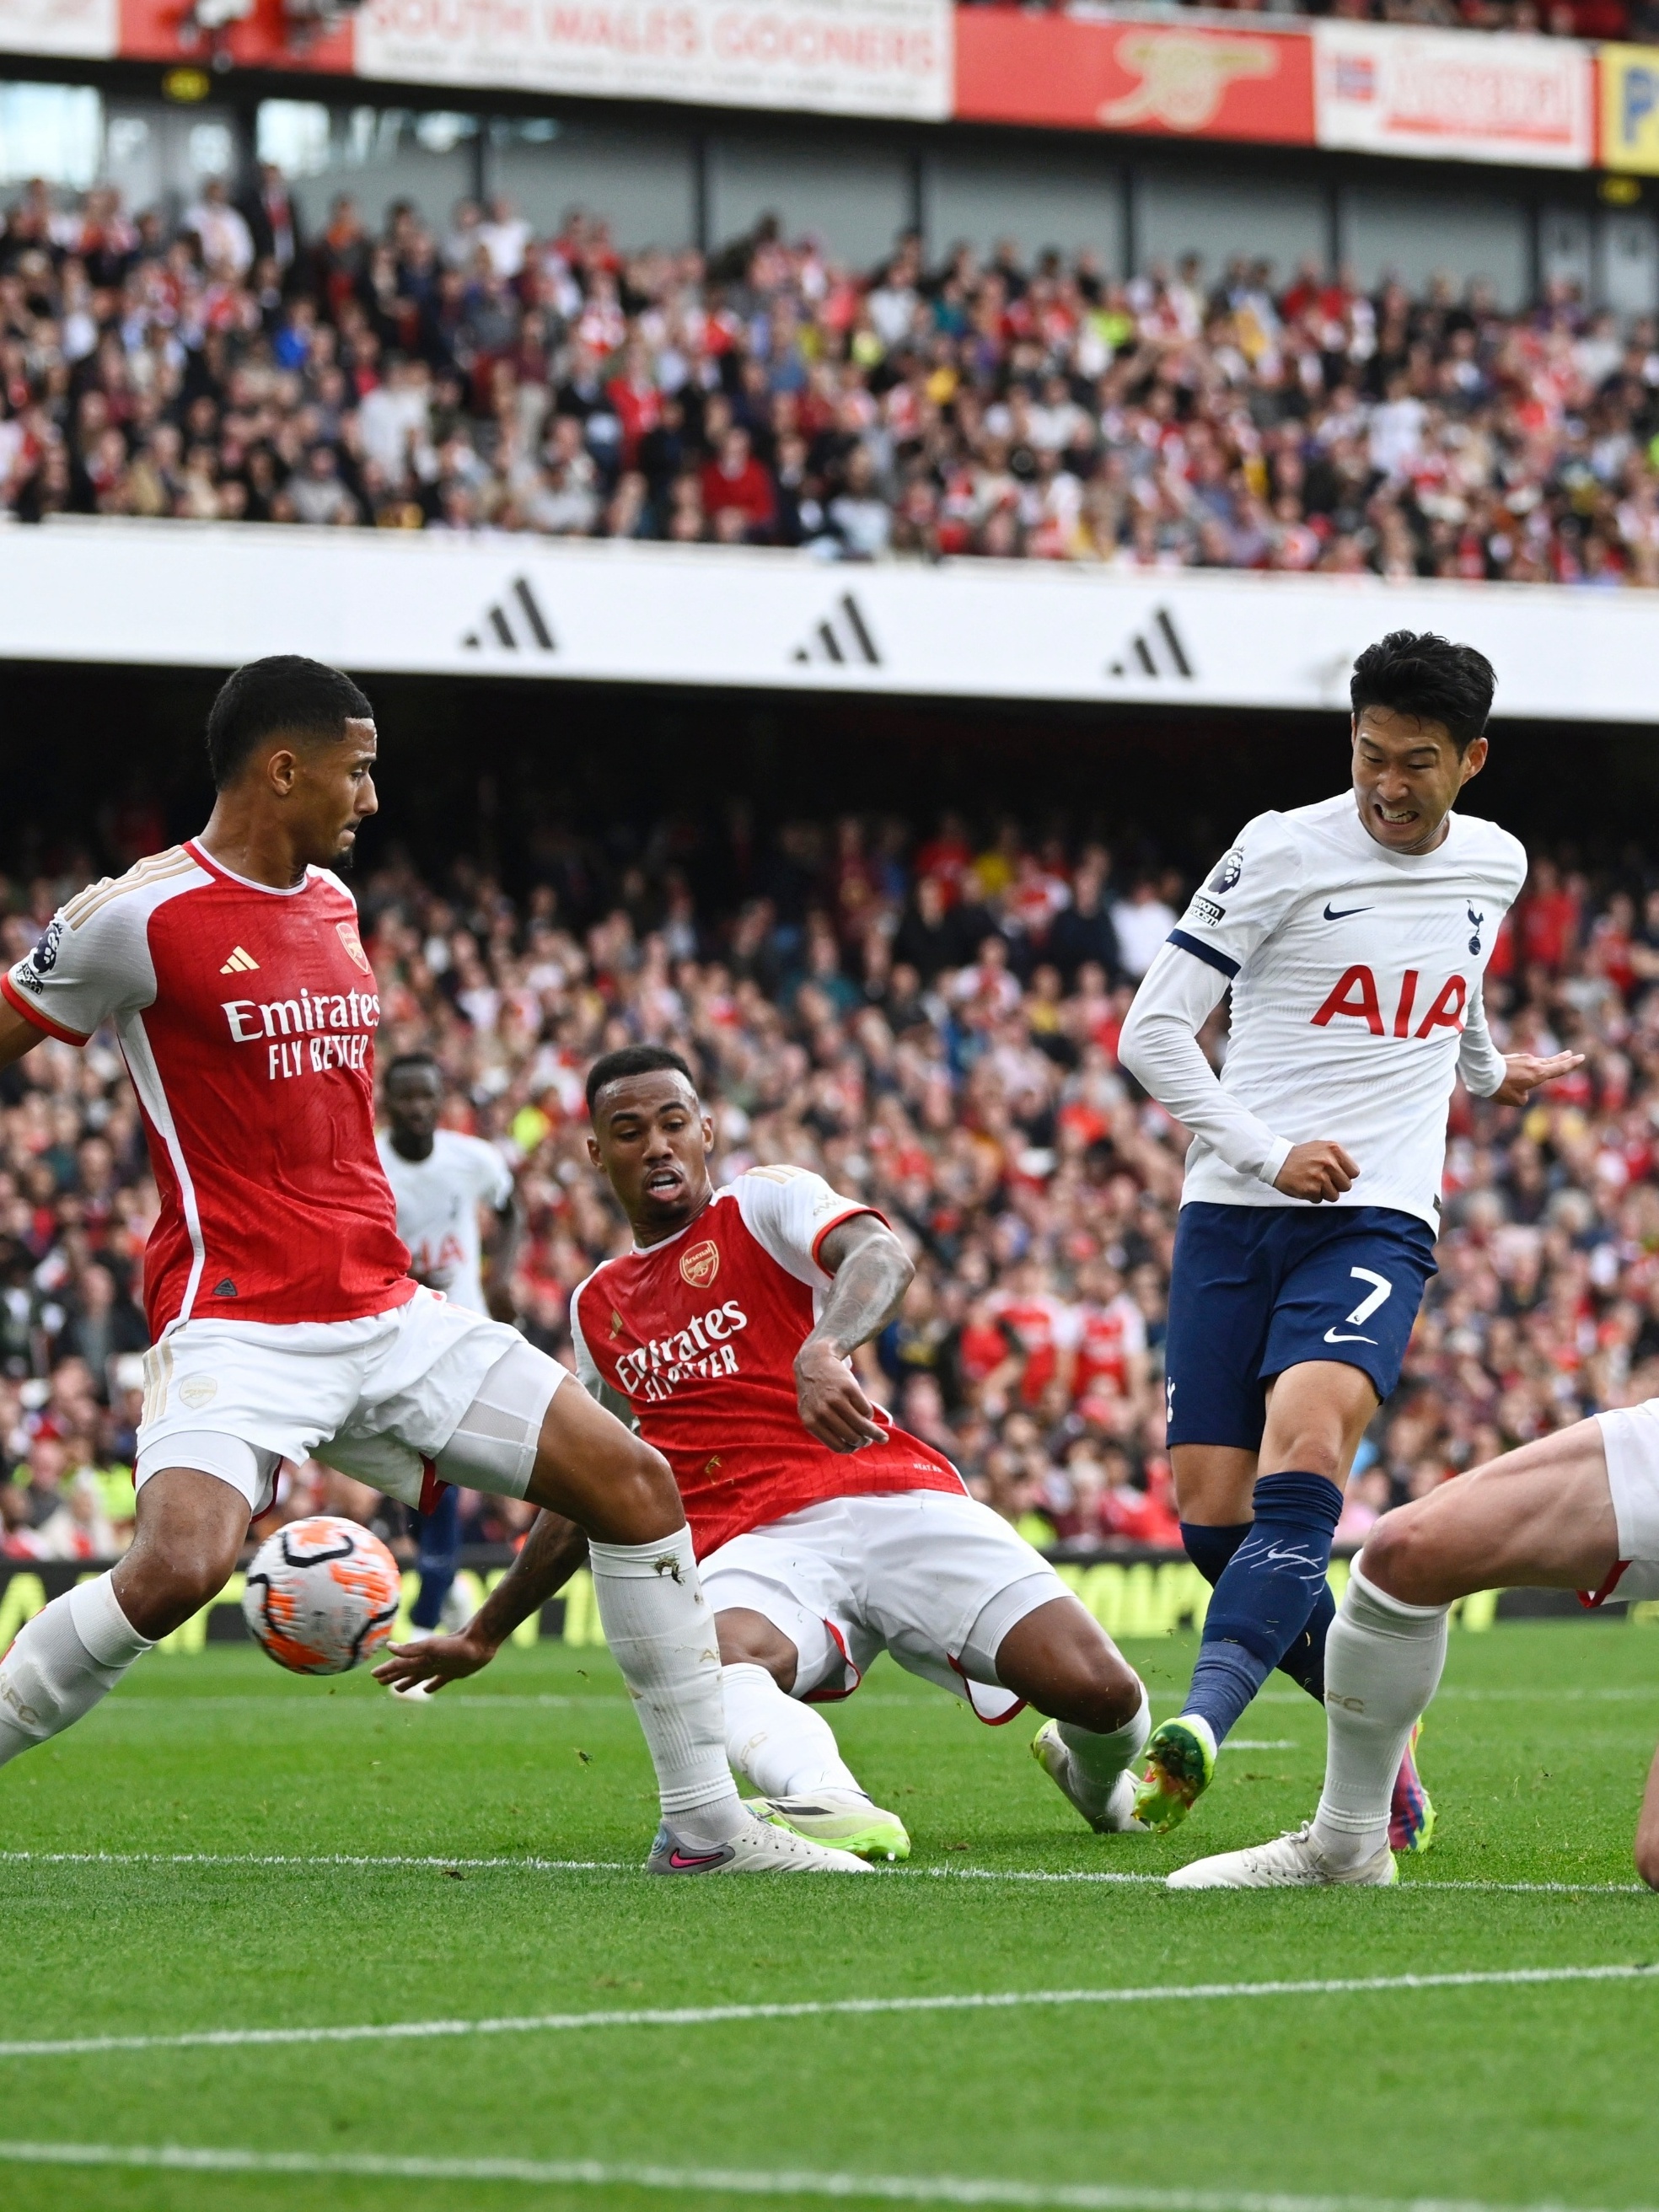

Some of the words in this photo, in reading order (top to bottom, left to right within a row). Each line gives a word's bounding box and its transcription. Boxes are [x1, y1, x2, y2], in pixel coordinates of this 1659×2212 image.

[221, 987, 380, 1043] Emirates
[1309, 964, 1467, 1039] AIA
[268, 1040, 302, 1080] FLY
[309, 1034, 369, 1073] BETTER
[421, 1235, 467, 1273] IA
[685, 1247, 711, 1265] Arsenal
[1345, 1266, 1393, 1326] 7
